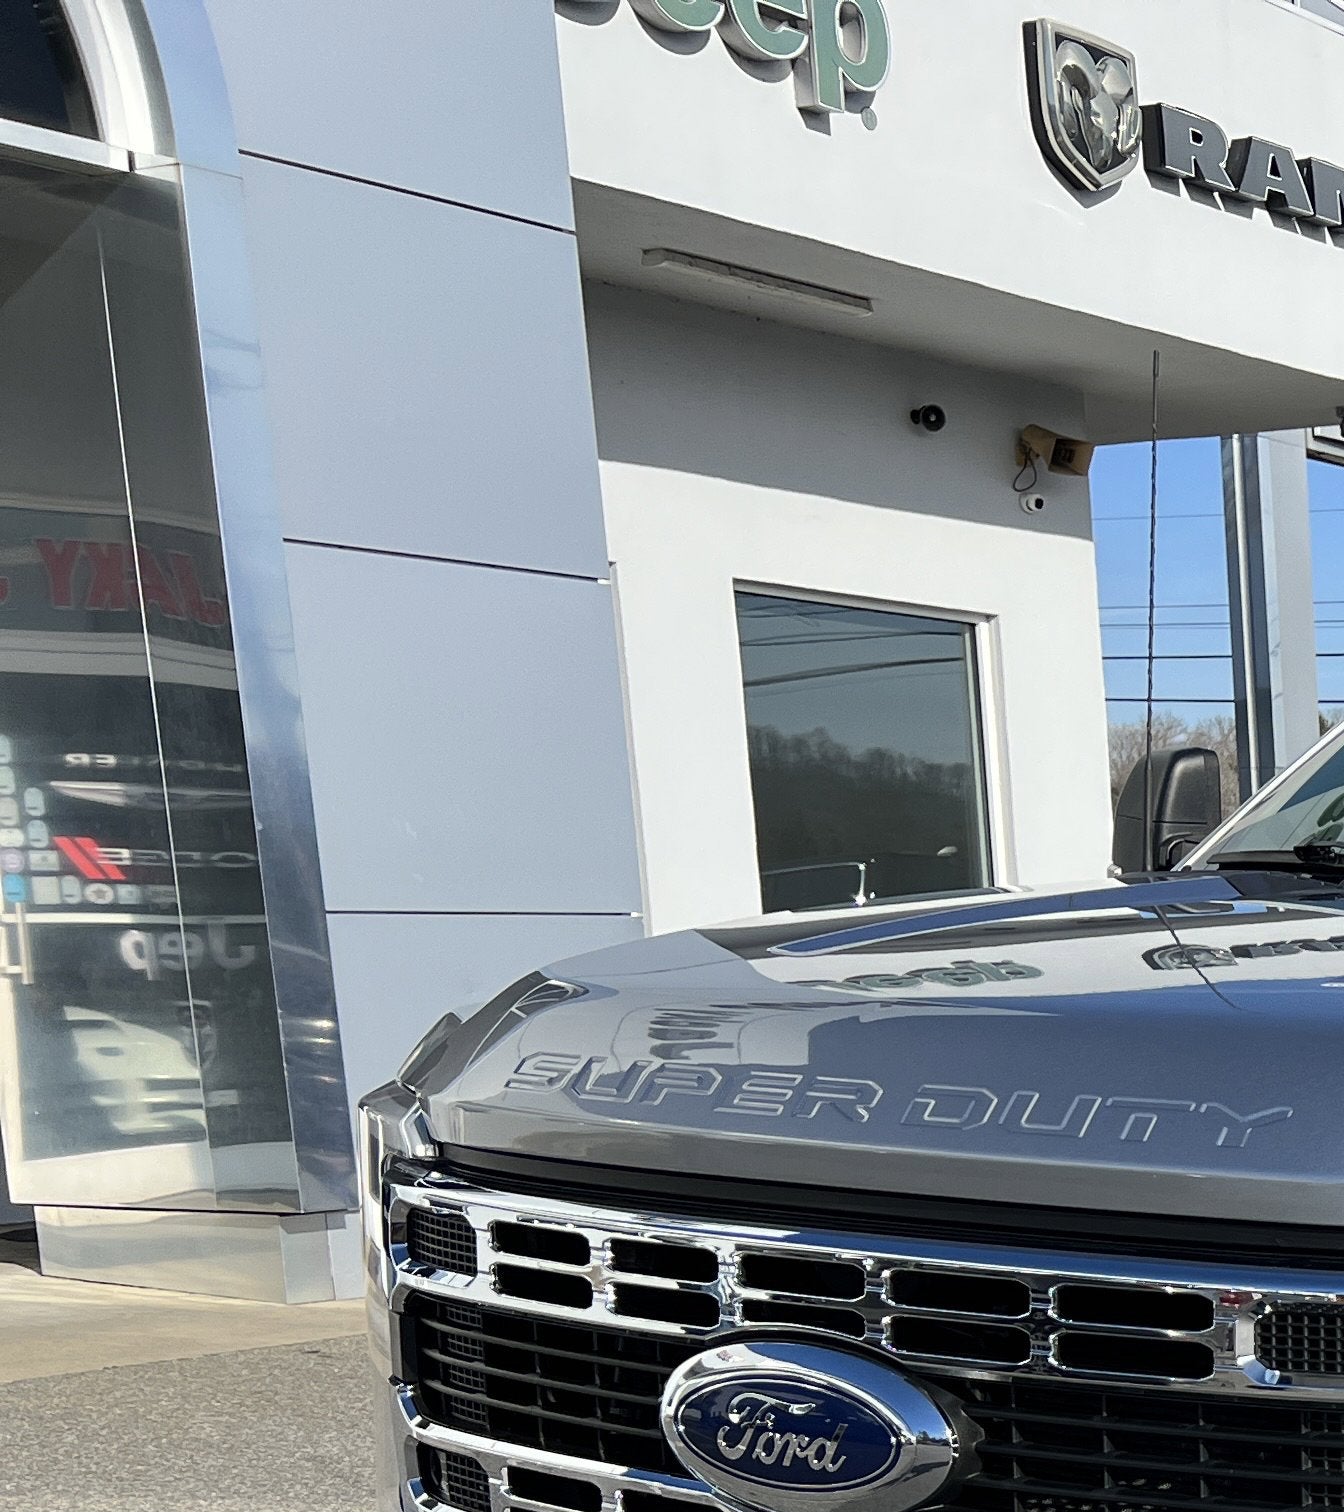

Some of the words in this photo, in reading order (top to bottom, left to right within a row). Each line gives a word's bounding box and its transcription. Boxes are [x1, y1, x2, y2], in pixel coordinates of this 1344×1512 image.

[503, 1051, 885, 1122] SUPER
[900, 1083, 1294, 1148] DUTY
[717, 1392, 849, 1473] Ford
